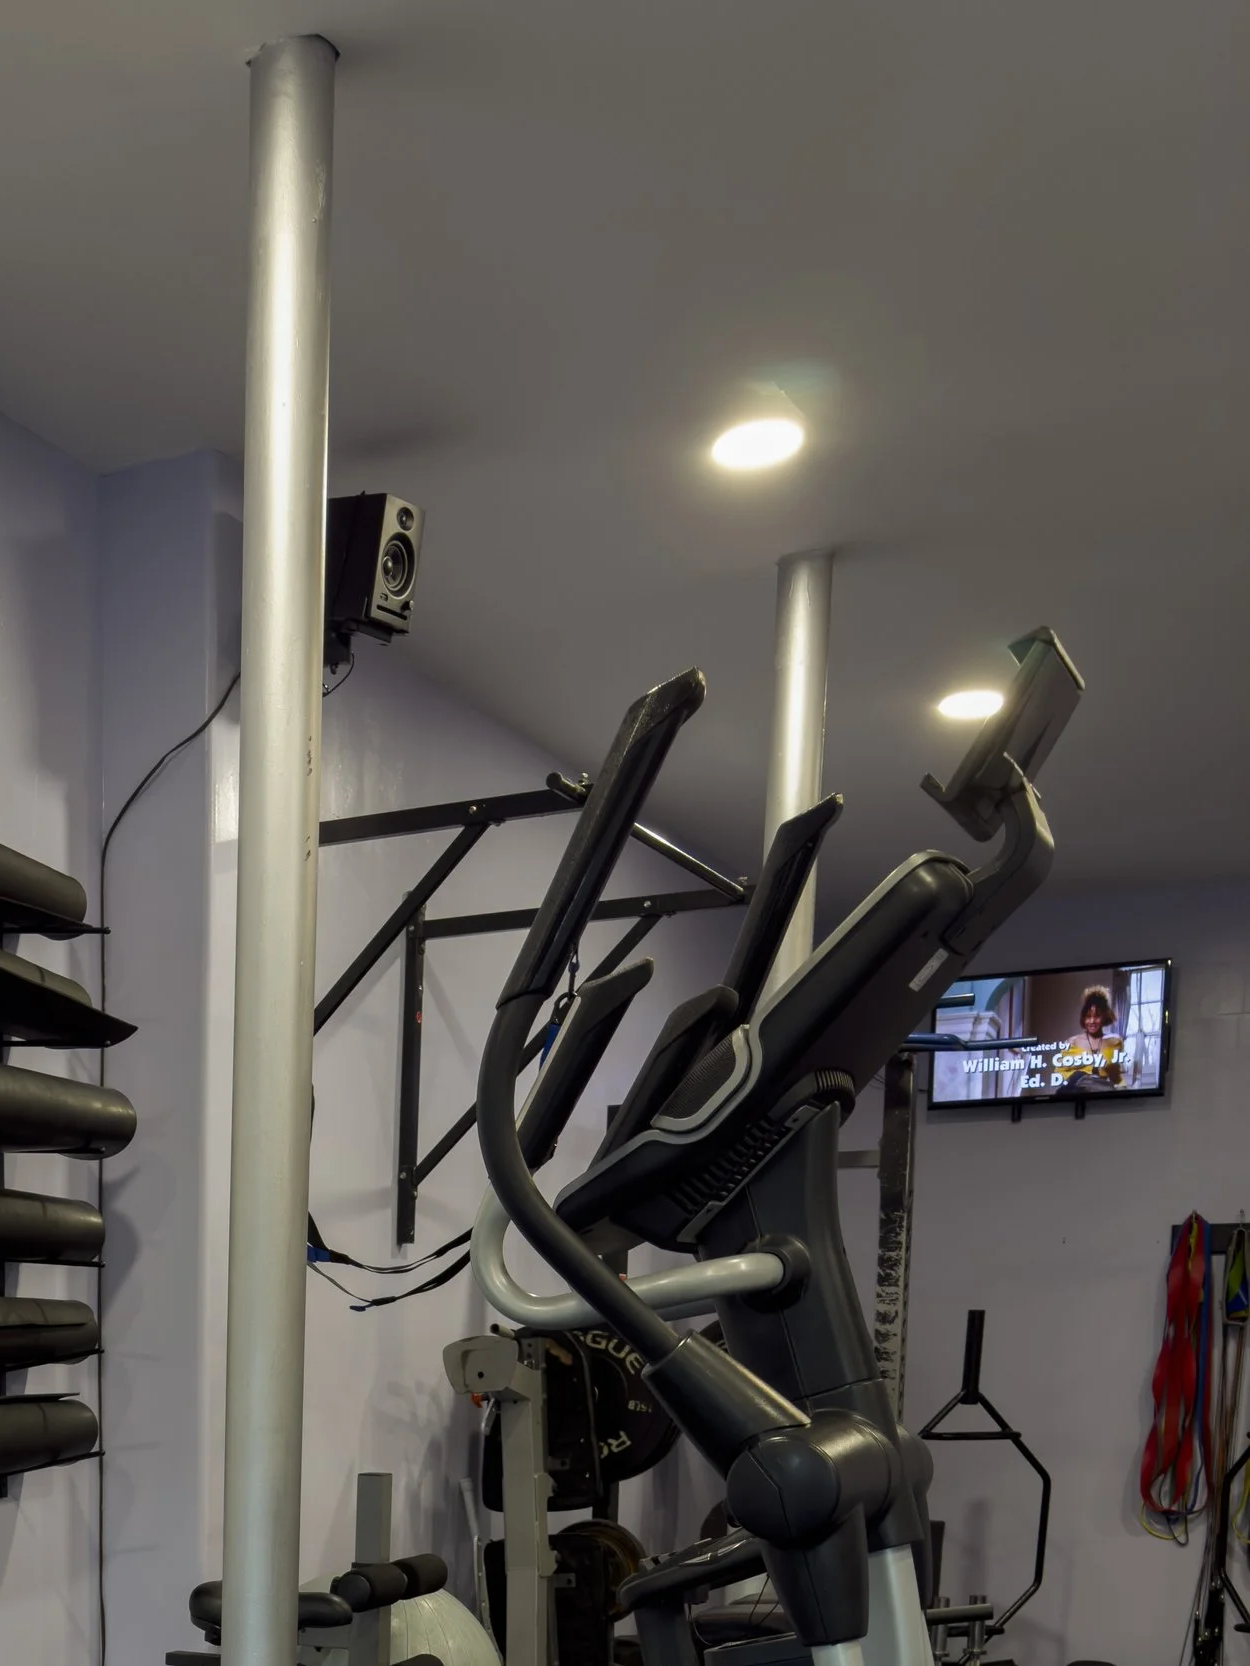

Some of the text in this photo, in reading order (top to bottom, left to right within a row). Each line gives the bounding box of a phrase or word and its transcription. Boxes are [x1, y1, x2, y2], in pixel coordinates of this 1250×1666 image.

[1058, 1040, 1071, 1052] by
[963, 1056, 1025, 1073] William
[1030, 1055, 1047, 1069] H.
[1021, 1073, 1069, 1089] Ed. D.
